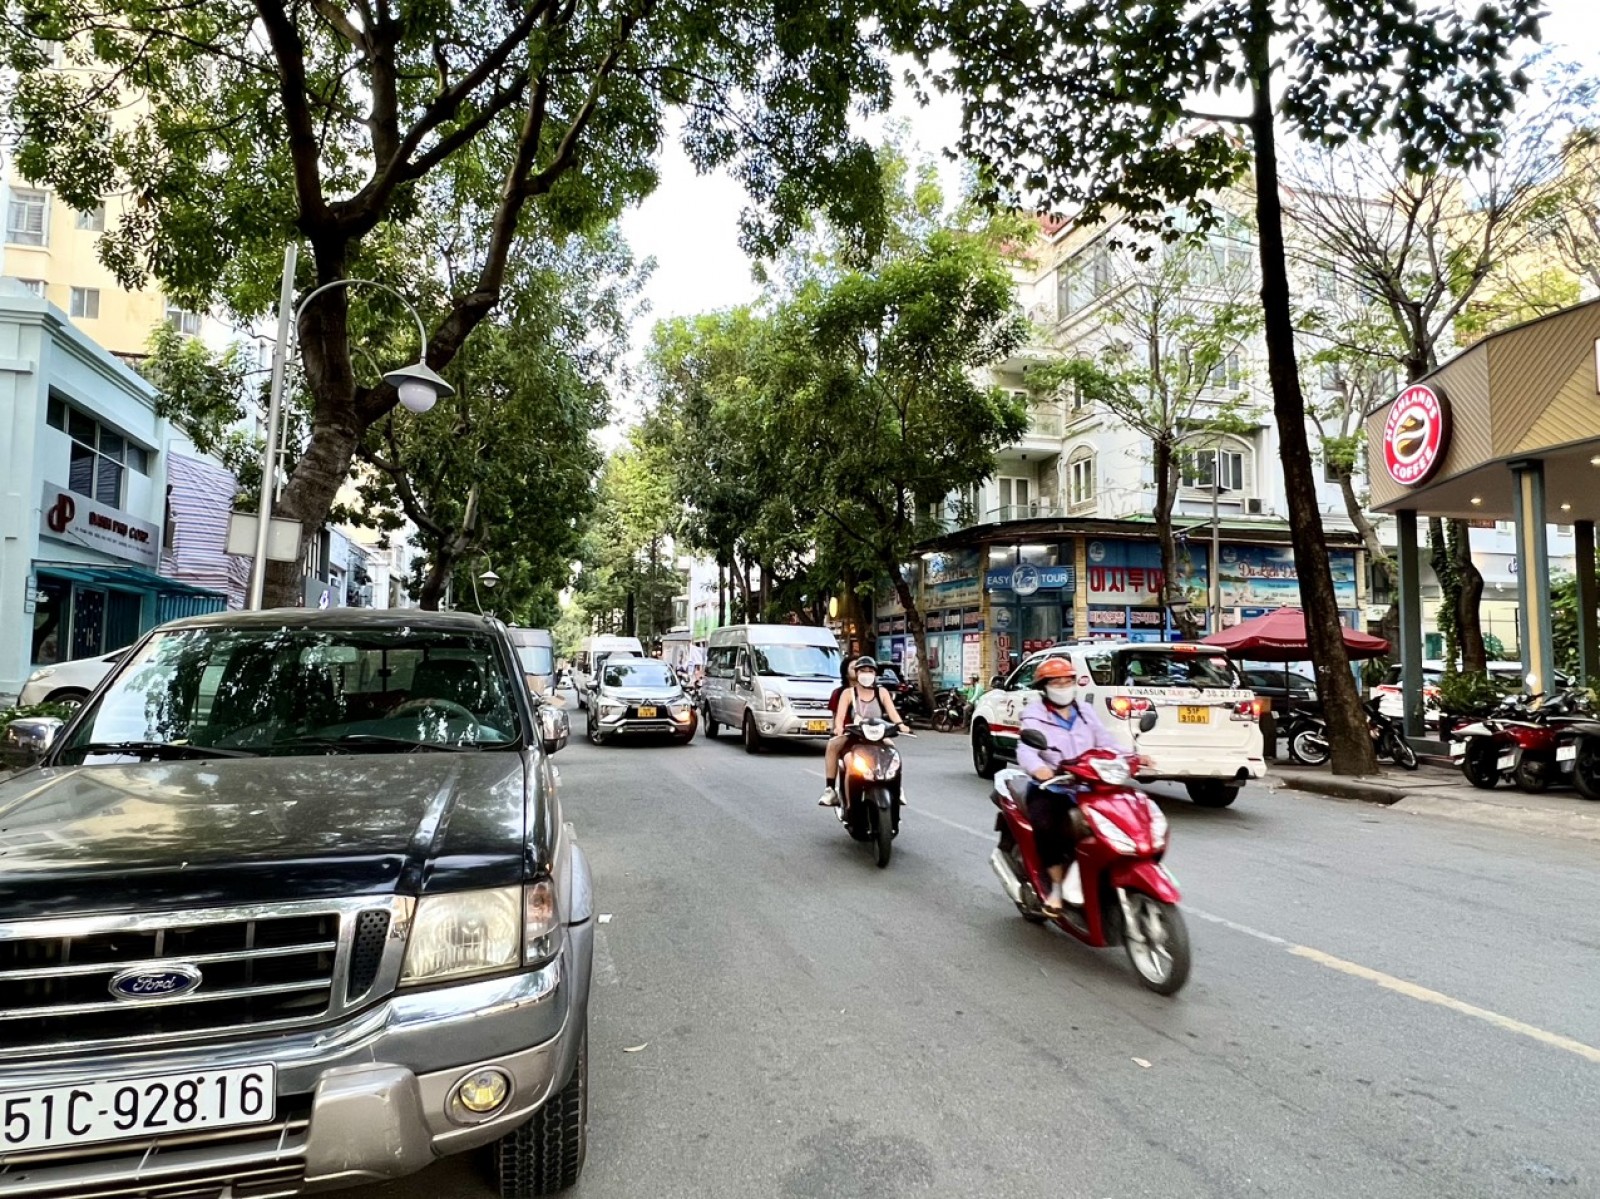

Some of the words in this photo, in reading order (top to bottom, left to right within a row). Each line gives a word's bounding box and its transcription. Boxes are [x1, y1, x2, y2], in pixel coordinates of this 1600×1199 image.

[1385, 390, 1437, 442] HIGHLANDS
[1392, 446, 1434, 481] COFFEE
[987, 576, 1009, 585] EASY
[1041, 573, 1068, 583] TOUR
[1127, 688, 1166, 696] VINASUN
[1168, 689, 1184, 697] TAXI
[1186, 706, 1200, 715] 51F
[132, 972, 177, 993] Ford
[4, 1073, 265, 1143] 51C-928.16
